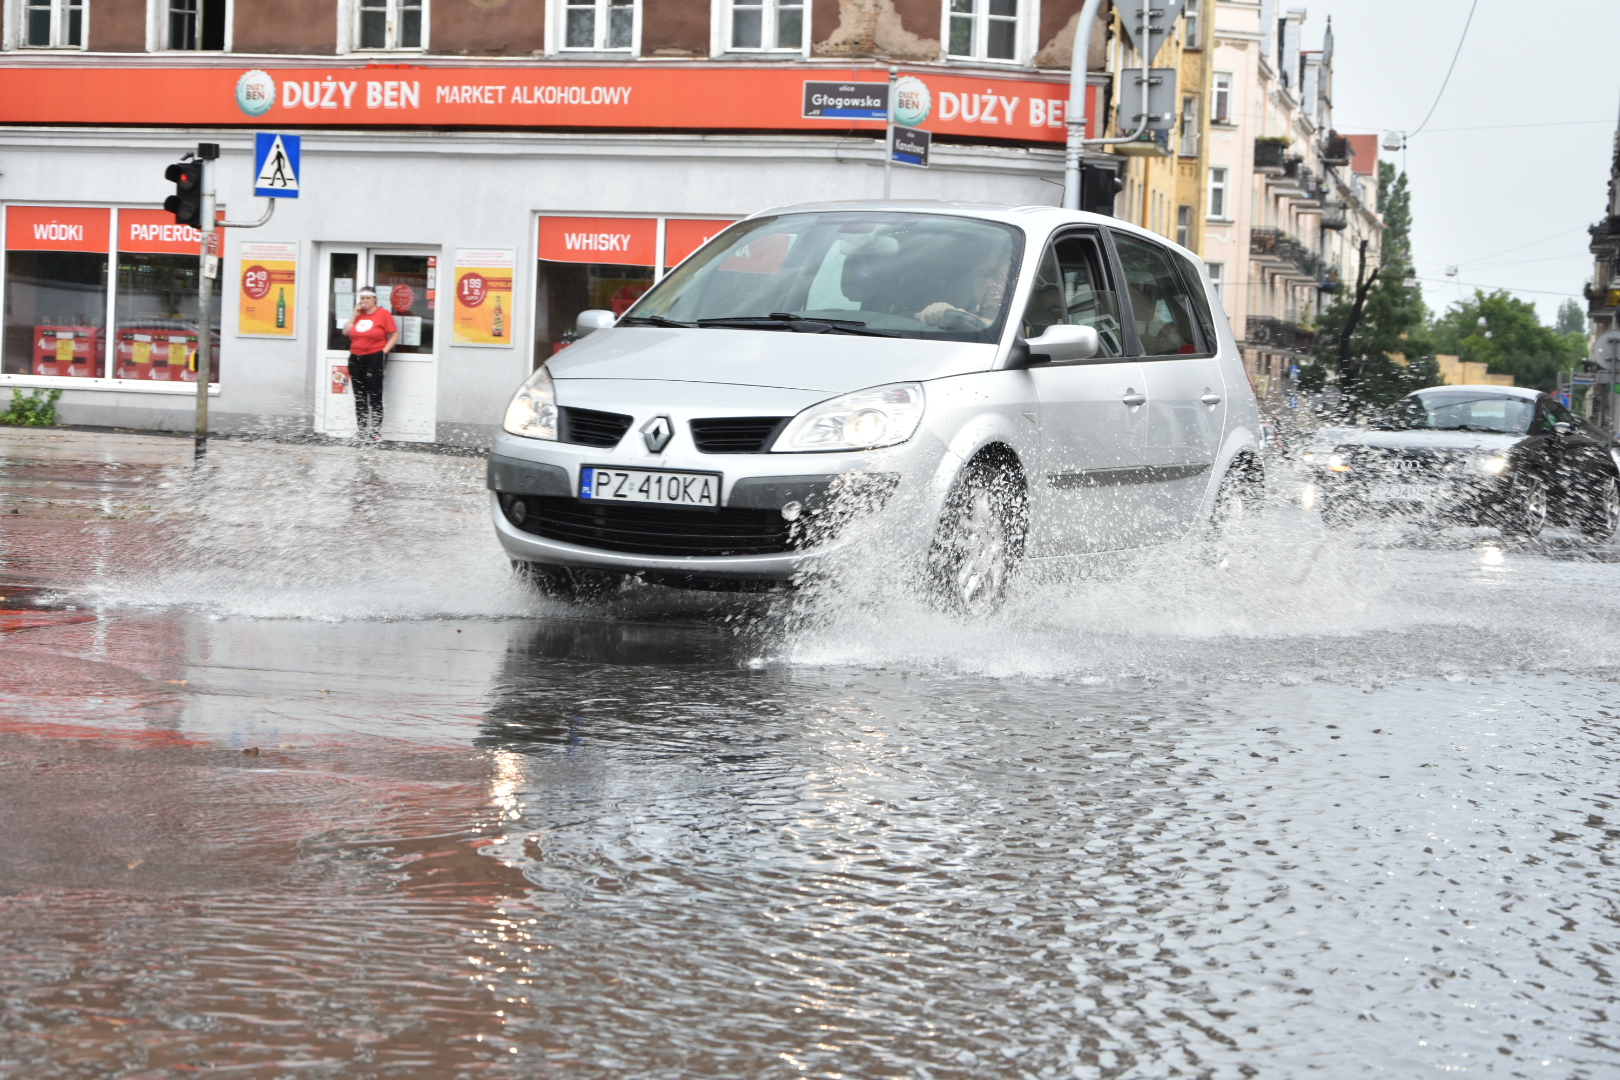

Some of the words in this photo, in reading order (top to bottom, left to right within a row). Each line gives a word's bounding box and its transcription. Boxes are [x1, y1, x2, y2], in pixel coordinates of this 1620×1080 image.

[246, 91, 265, 100] BEN
[282, 75, 358, 109] DUŻY
[366, 80, 420, 109] BEN
[435, 85, 506, 104] MARKET
[510, 85, 632, 105] ALKOHOLOWY
[811, 93, 881, 109] Głogowska
[898, 91, 919, 100] DUŻY
[898, 99, 919, 110] BEN
[939, 88, 1019, 125] DUŻY
[1029, 98, 1070, 128] BE
[33, 220, 83, 241] WÓDKI
[130, 223, 202, 242] PAPIEROS
[564, 232, 631, 252] WHISKY
[595, 471, 629, 498] PZ
[638, 474, 712, 504] 410KA
